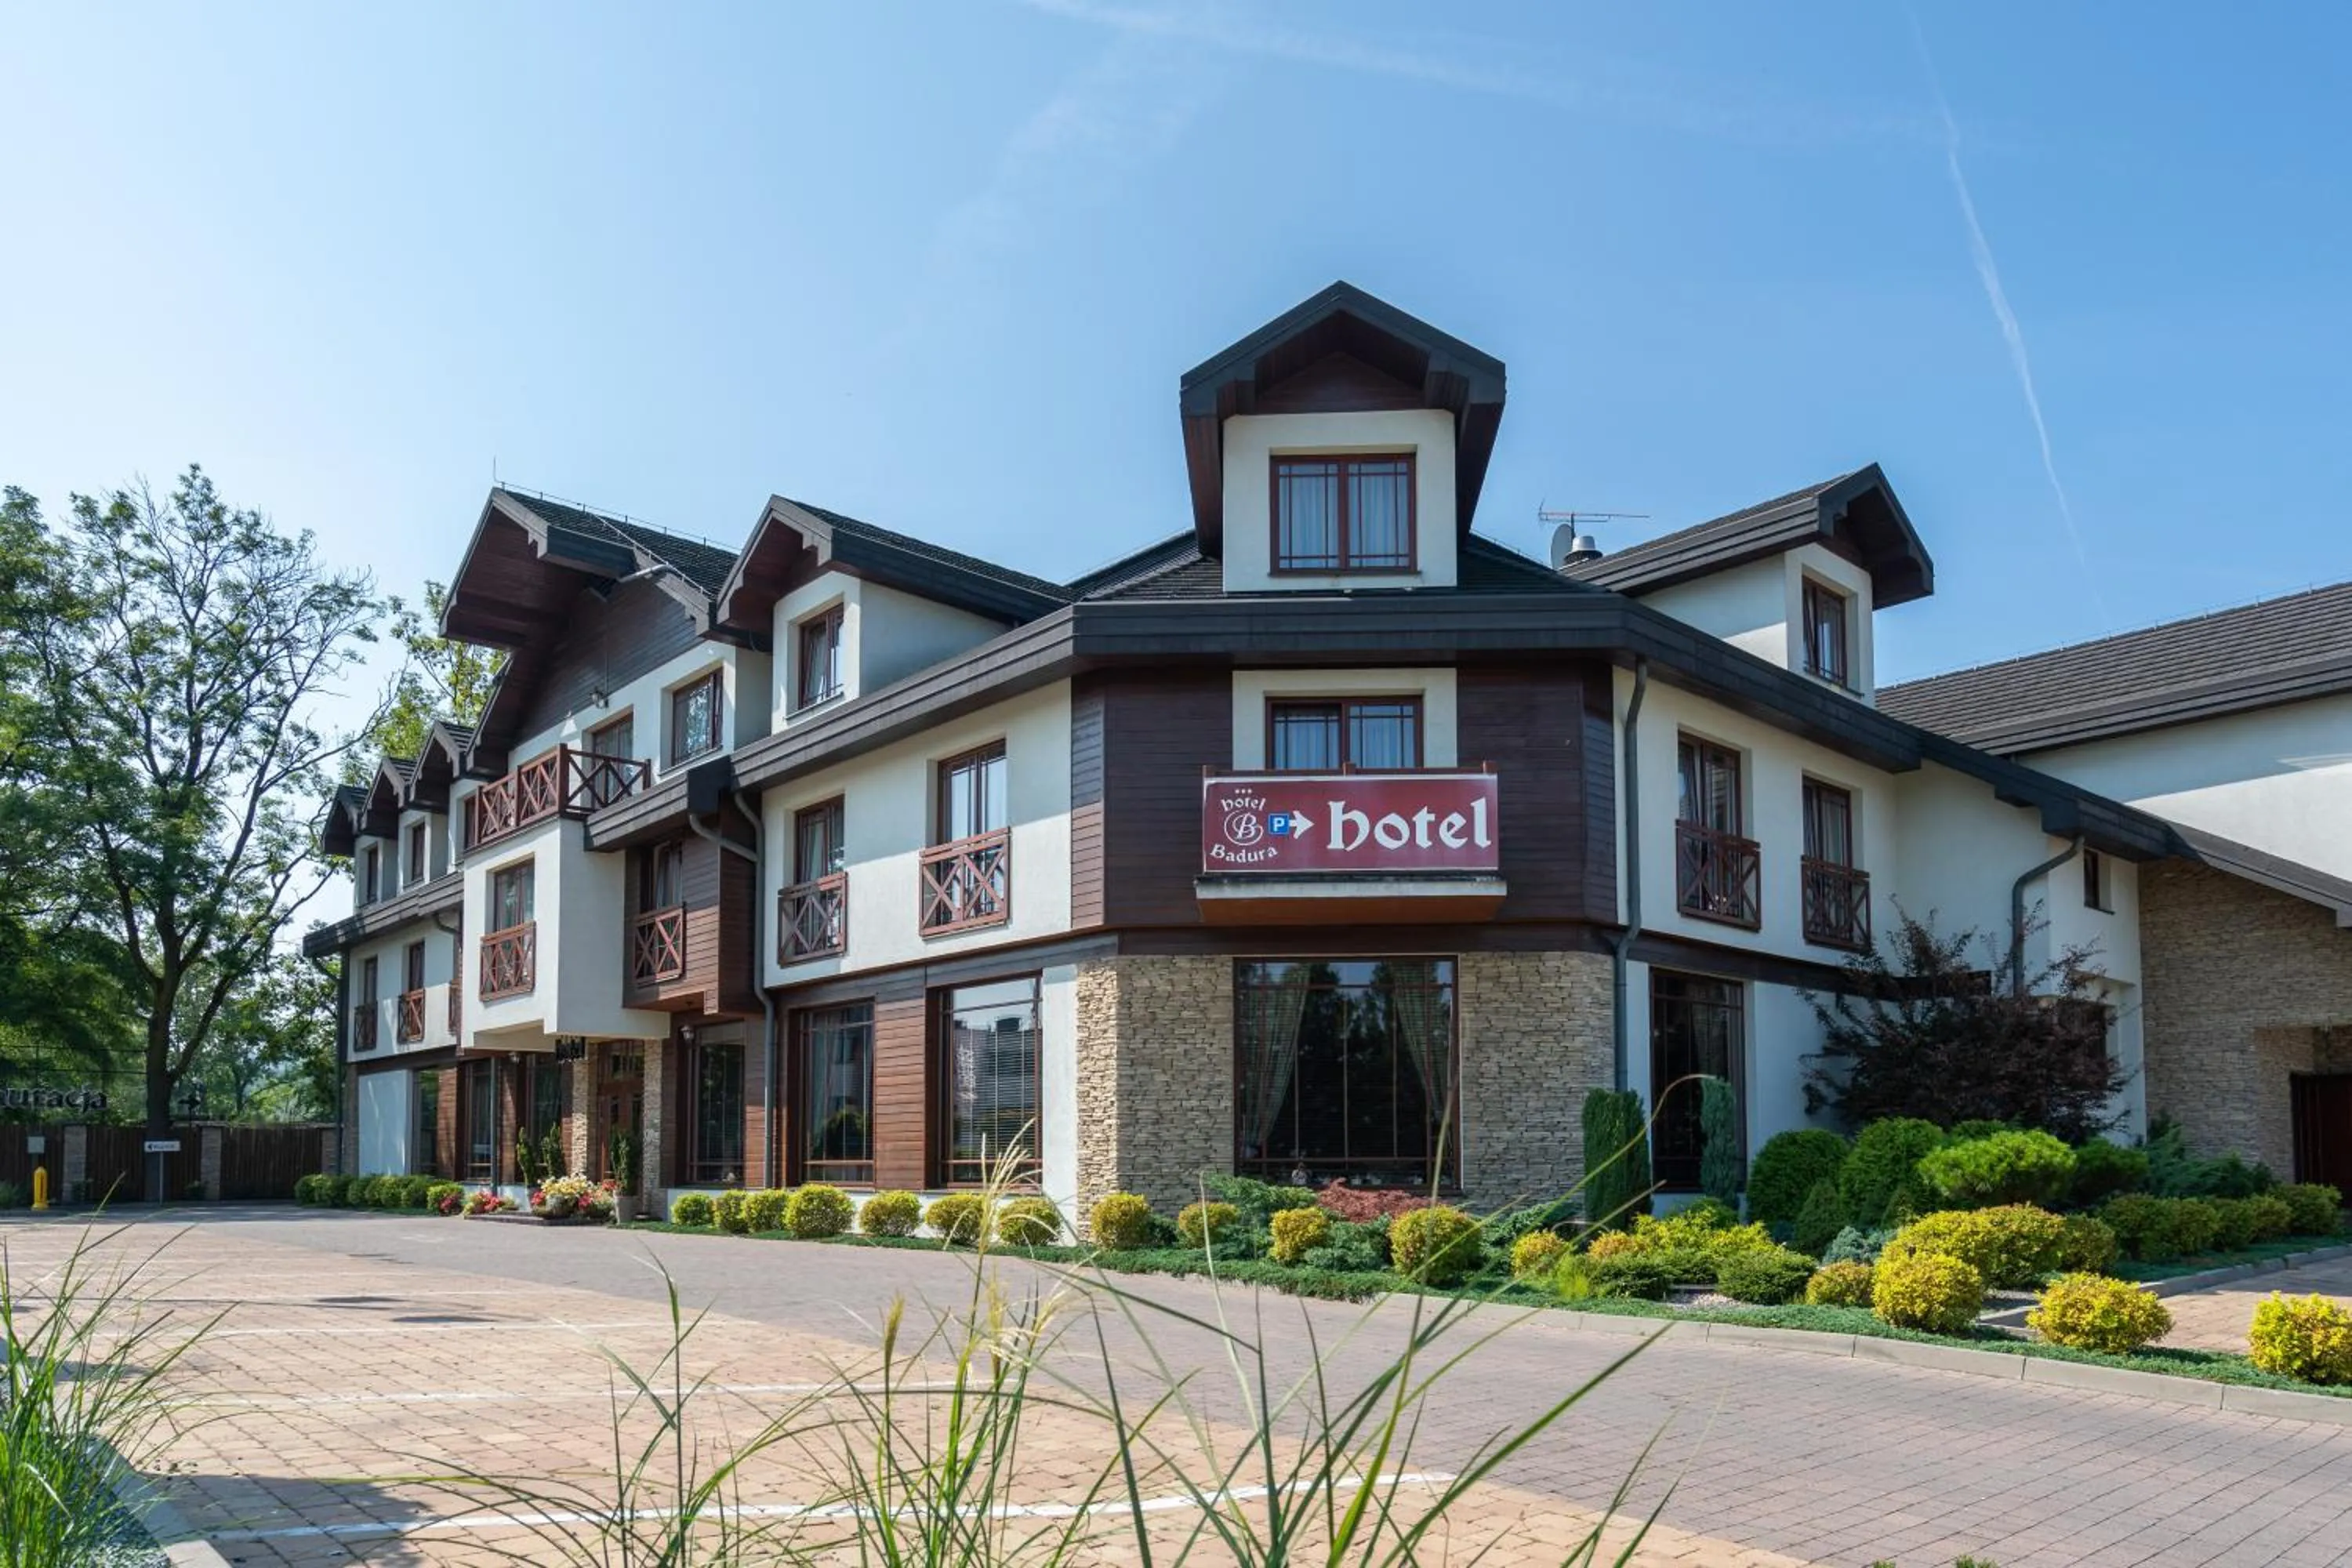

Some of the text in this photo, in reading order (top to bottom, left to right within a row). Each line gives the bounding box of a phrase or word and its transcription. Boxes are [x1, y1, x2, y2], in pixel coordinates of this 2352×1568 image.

[1221, 797, 1266, 811] hotel
[1272, 797, 1491, 851] P hotel
[1210, 844, 1278, 862] Badura
